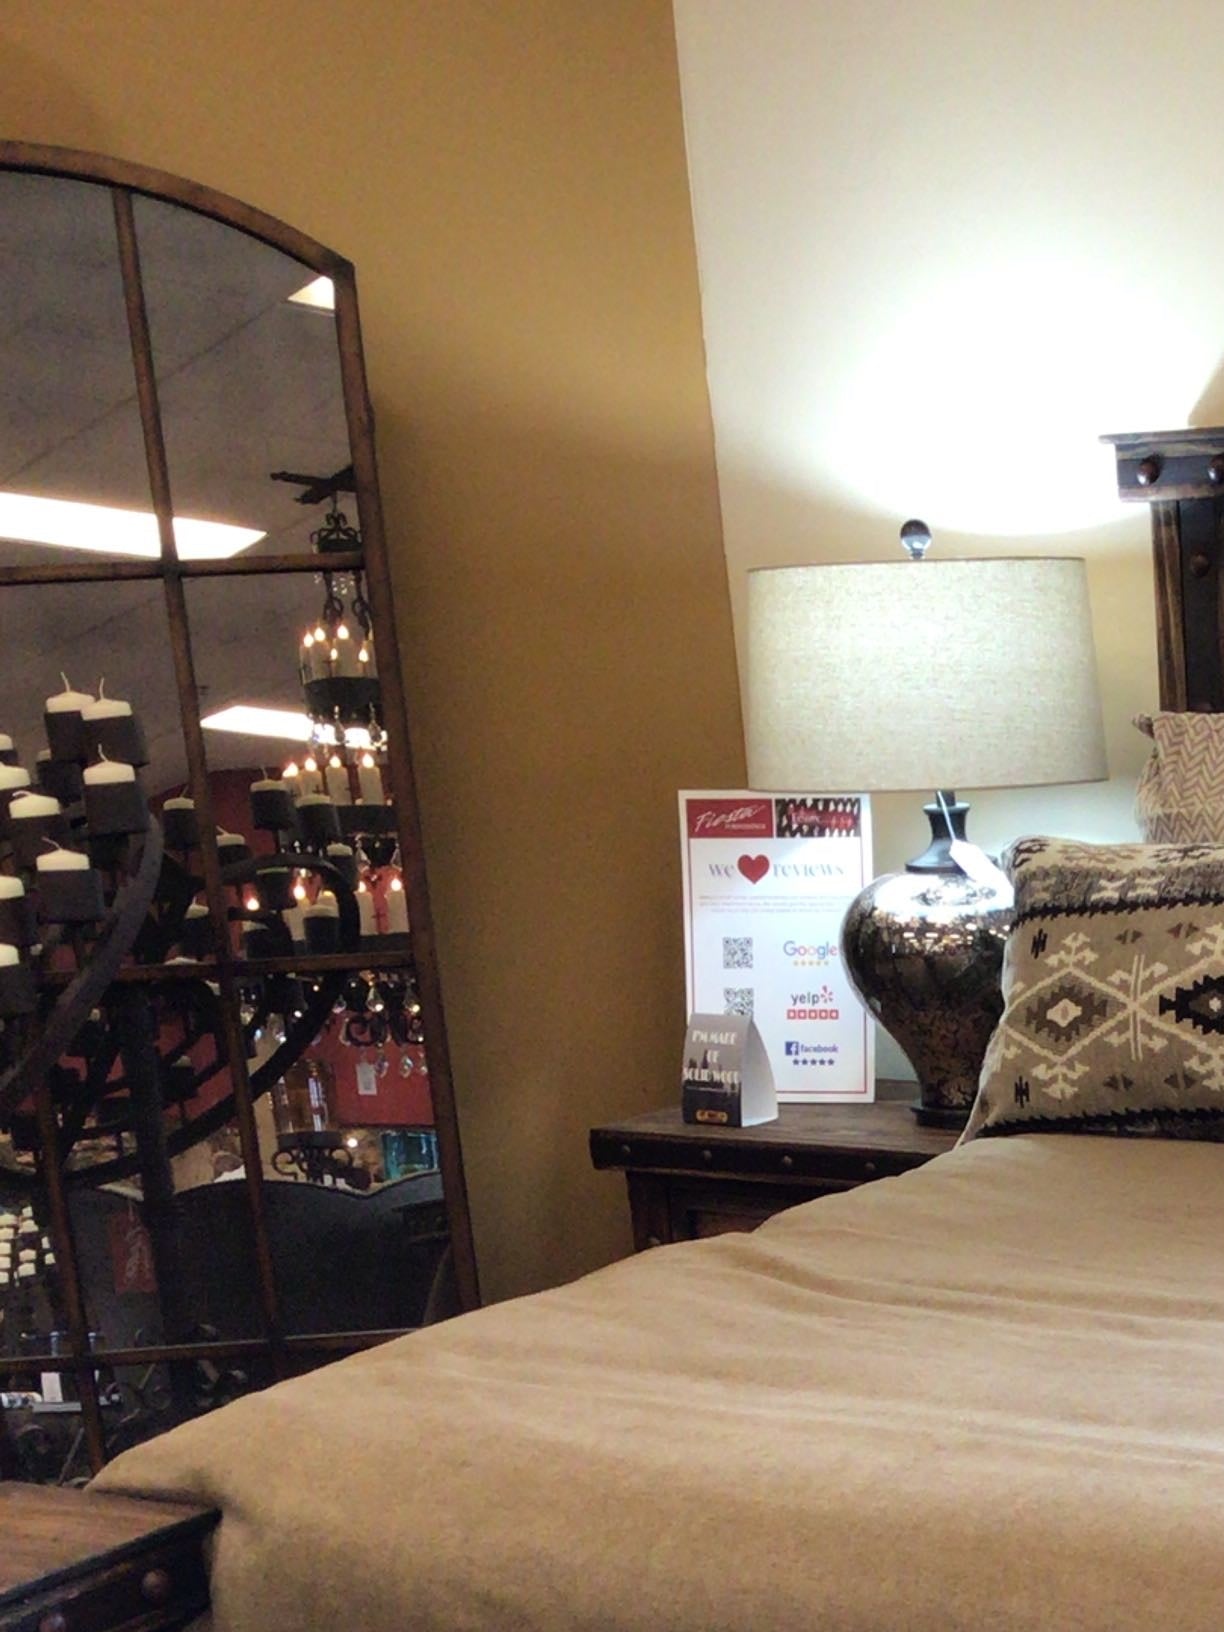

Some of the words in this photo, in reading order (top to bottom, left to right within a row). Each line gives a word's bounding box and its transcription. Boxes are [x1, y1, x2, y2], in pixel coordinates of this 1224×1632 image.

[783, 940, 838, 960] Google
[791, 991, 820, 1007] yelp
[800, 1043, 839, 1054] facebook
